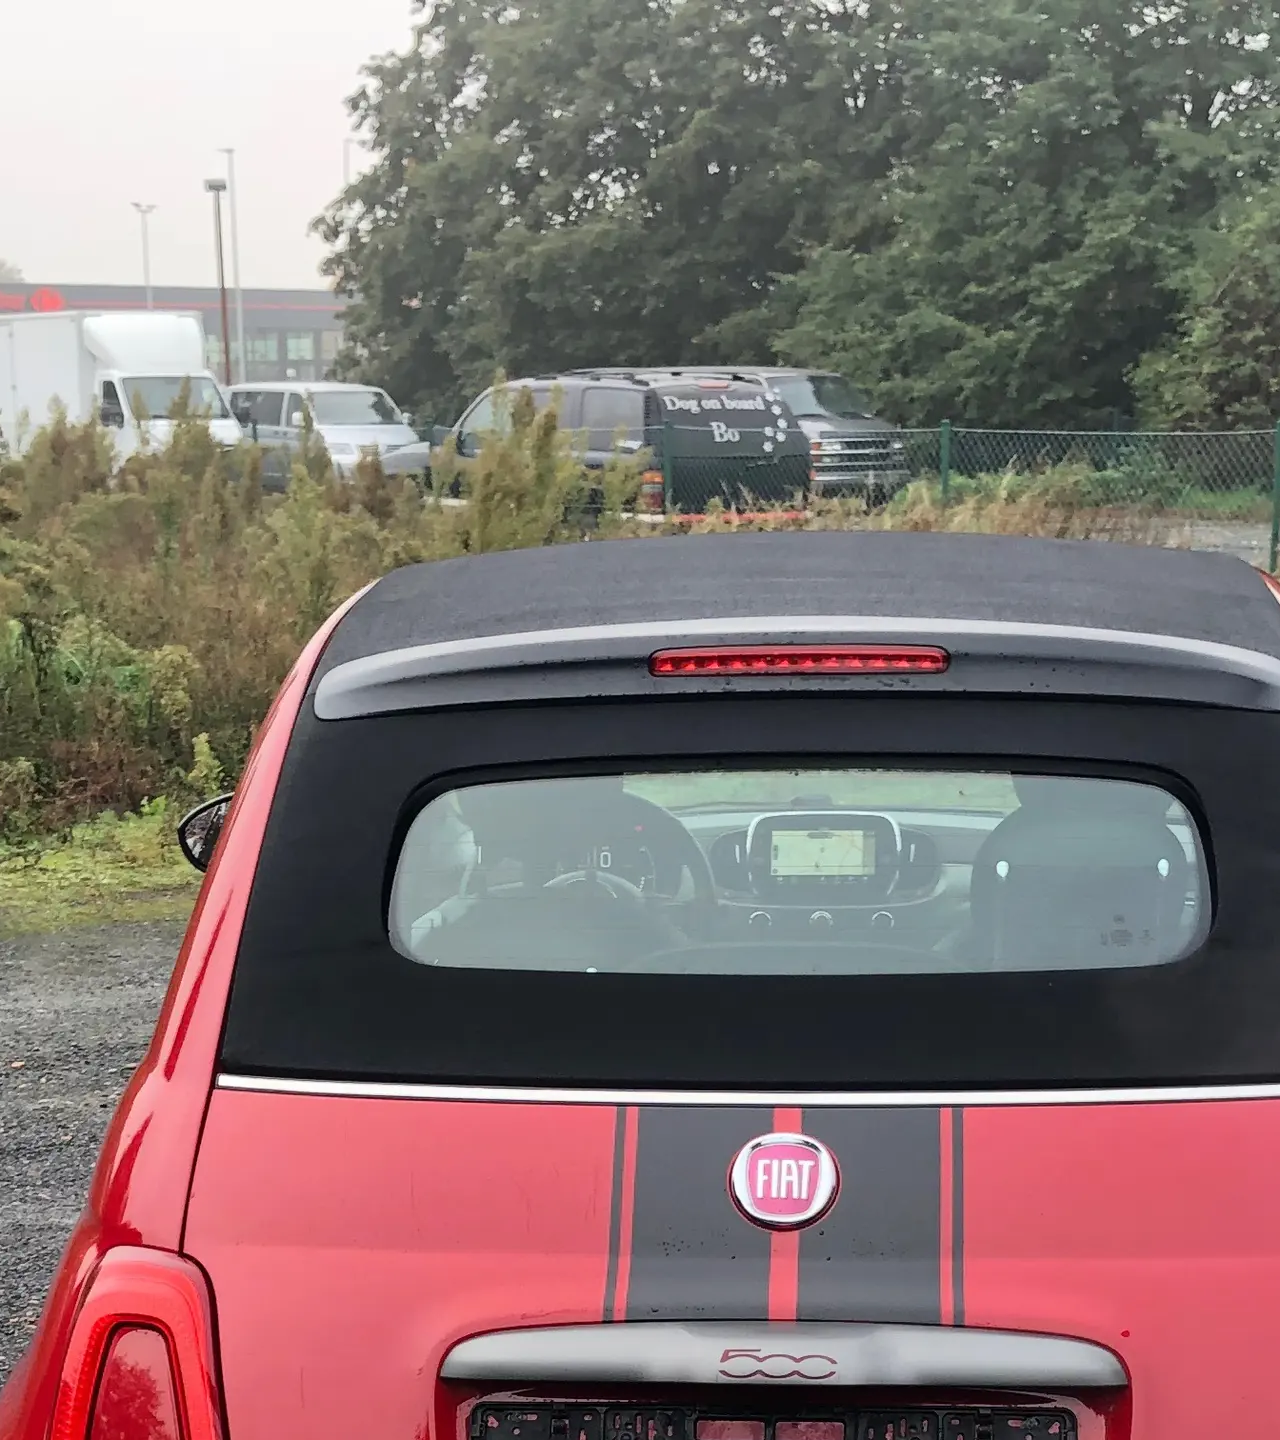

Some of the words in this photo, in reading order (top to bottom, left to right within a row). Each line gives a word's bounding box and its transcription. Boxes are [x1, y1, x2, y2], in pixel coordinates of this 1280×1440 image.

[663, 395, 701, 414] Dog
[701, 399, 722, 410] on
[720, 395, 766, 410] board
[709, 421, 740, 442] Bo
[756, 1158, 816, 1200] FIAT
[718, 1348, 838, 1380] 500
